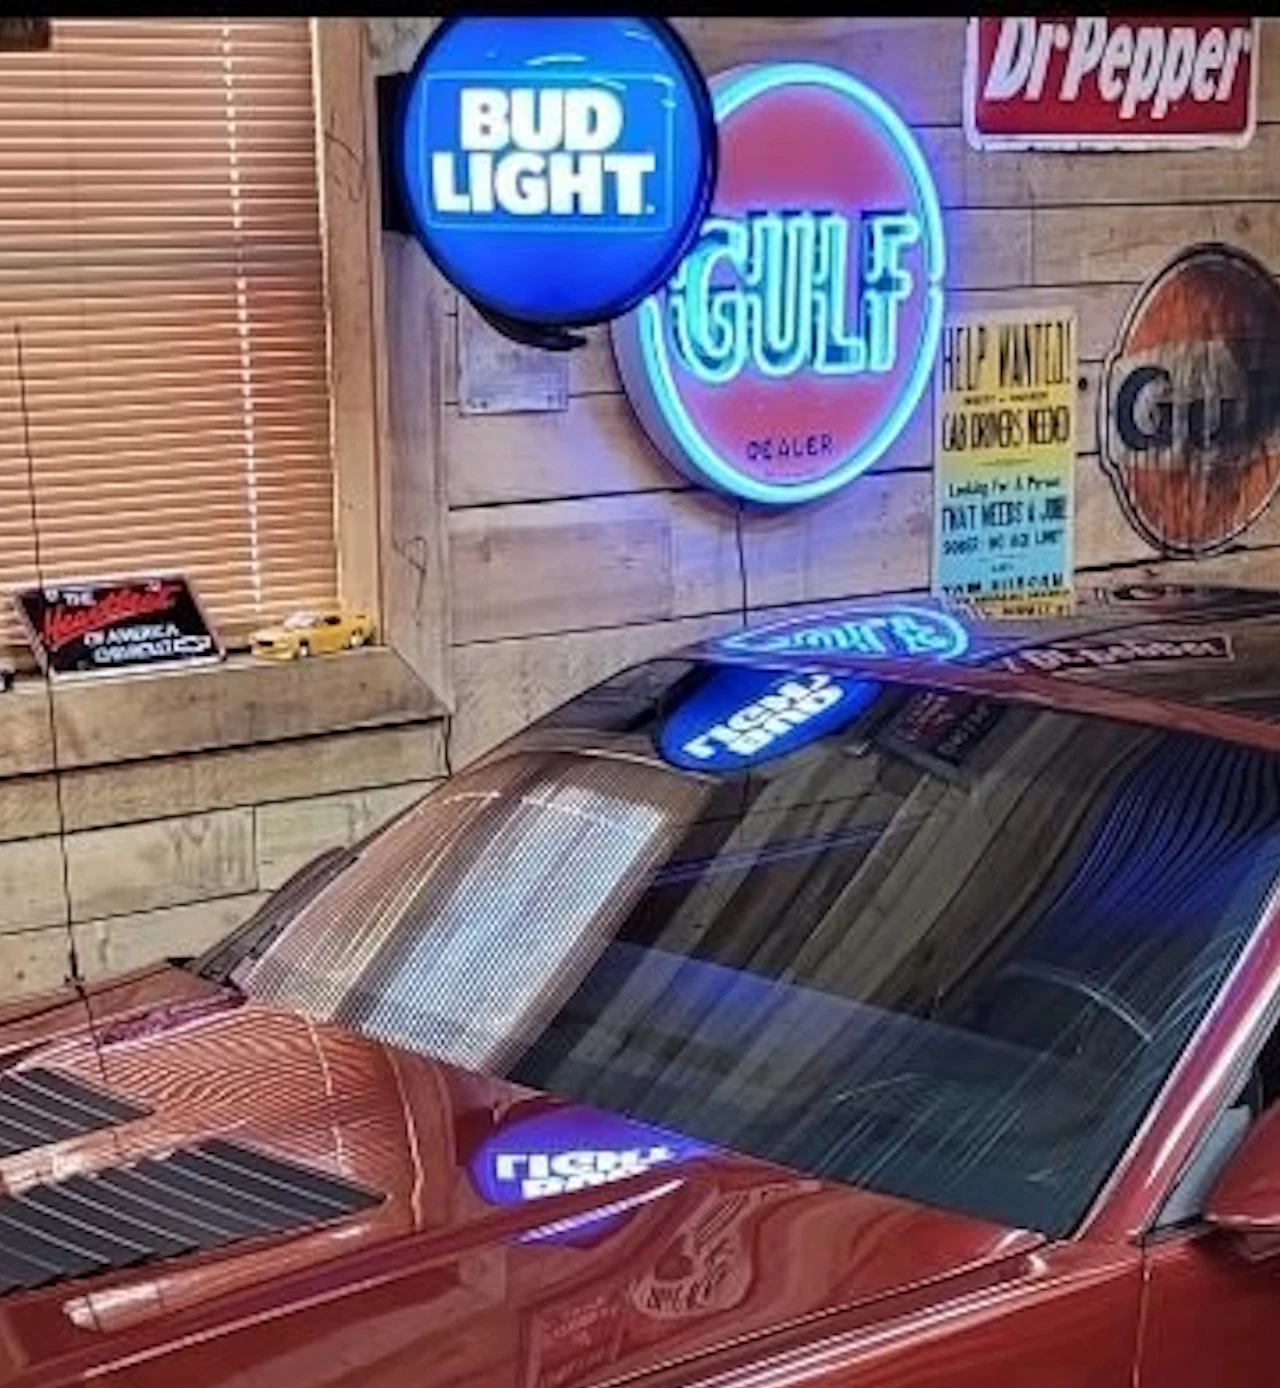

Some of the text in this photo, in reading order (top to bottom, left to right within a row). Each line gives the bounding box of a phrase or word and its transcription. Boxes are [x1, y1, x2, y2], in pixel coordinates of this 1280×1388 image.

[459, 87, 624, 151] BUD
[430, 152, 656, 215] LIGHT
[669, 211, 922, 385] GULF
[942, 320, 1071, 393] HELP WANTED!
[745, 433, 835, 462] DEALER
[943, 412, 967, 451] CAB
